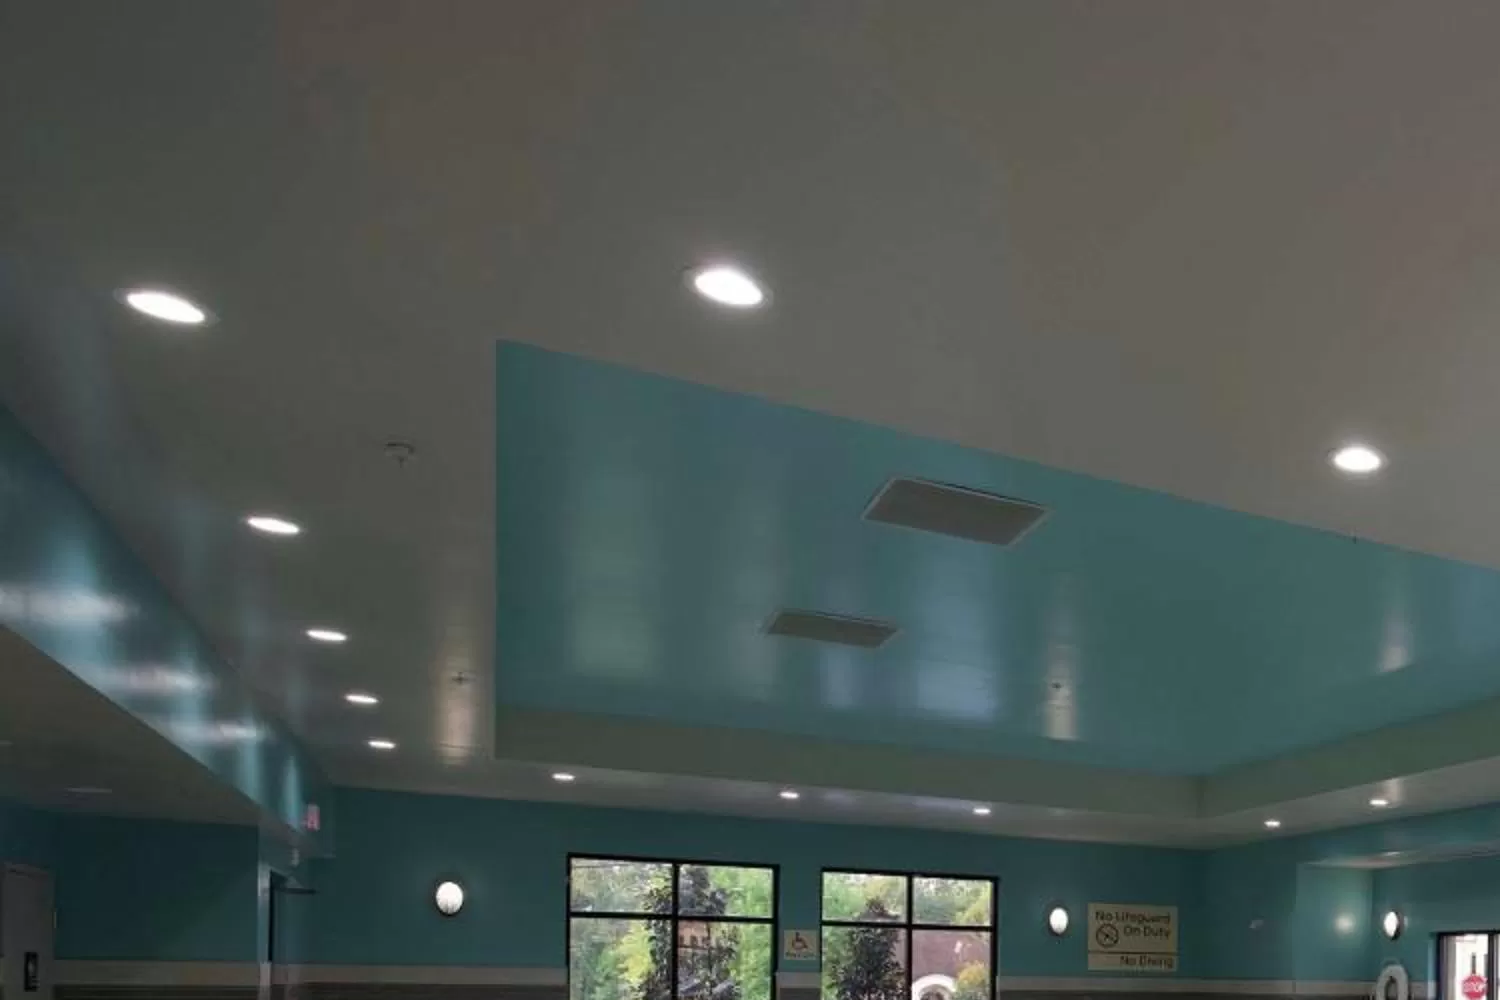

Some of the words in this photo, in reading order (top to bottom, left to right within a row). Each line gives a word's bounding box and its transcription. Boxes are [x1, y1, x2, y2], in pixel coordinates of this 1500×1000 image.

[1095, 911, 1113, 921] No
[1115, 911, 1171, 924] Lifeguard
[1123, 925, 1141, 937] On
[1143, 925, 1170, 940] Duty
